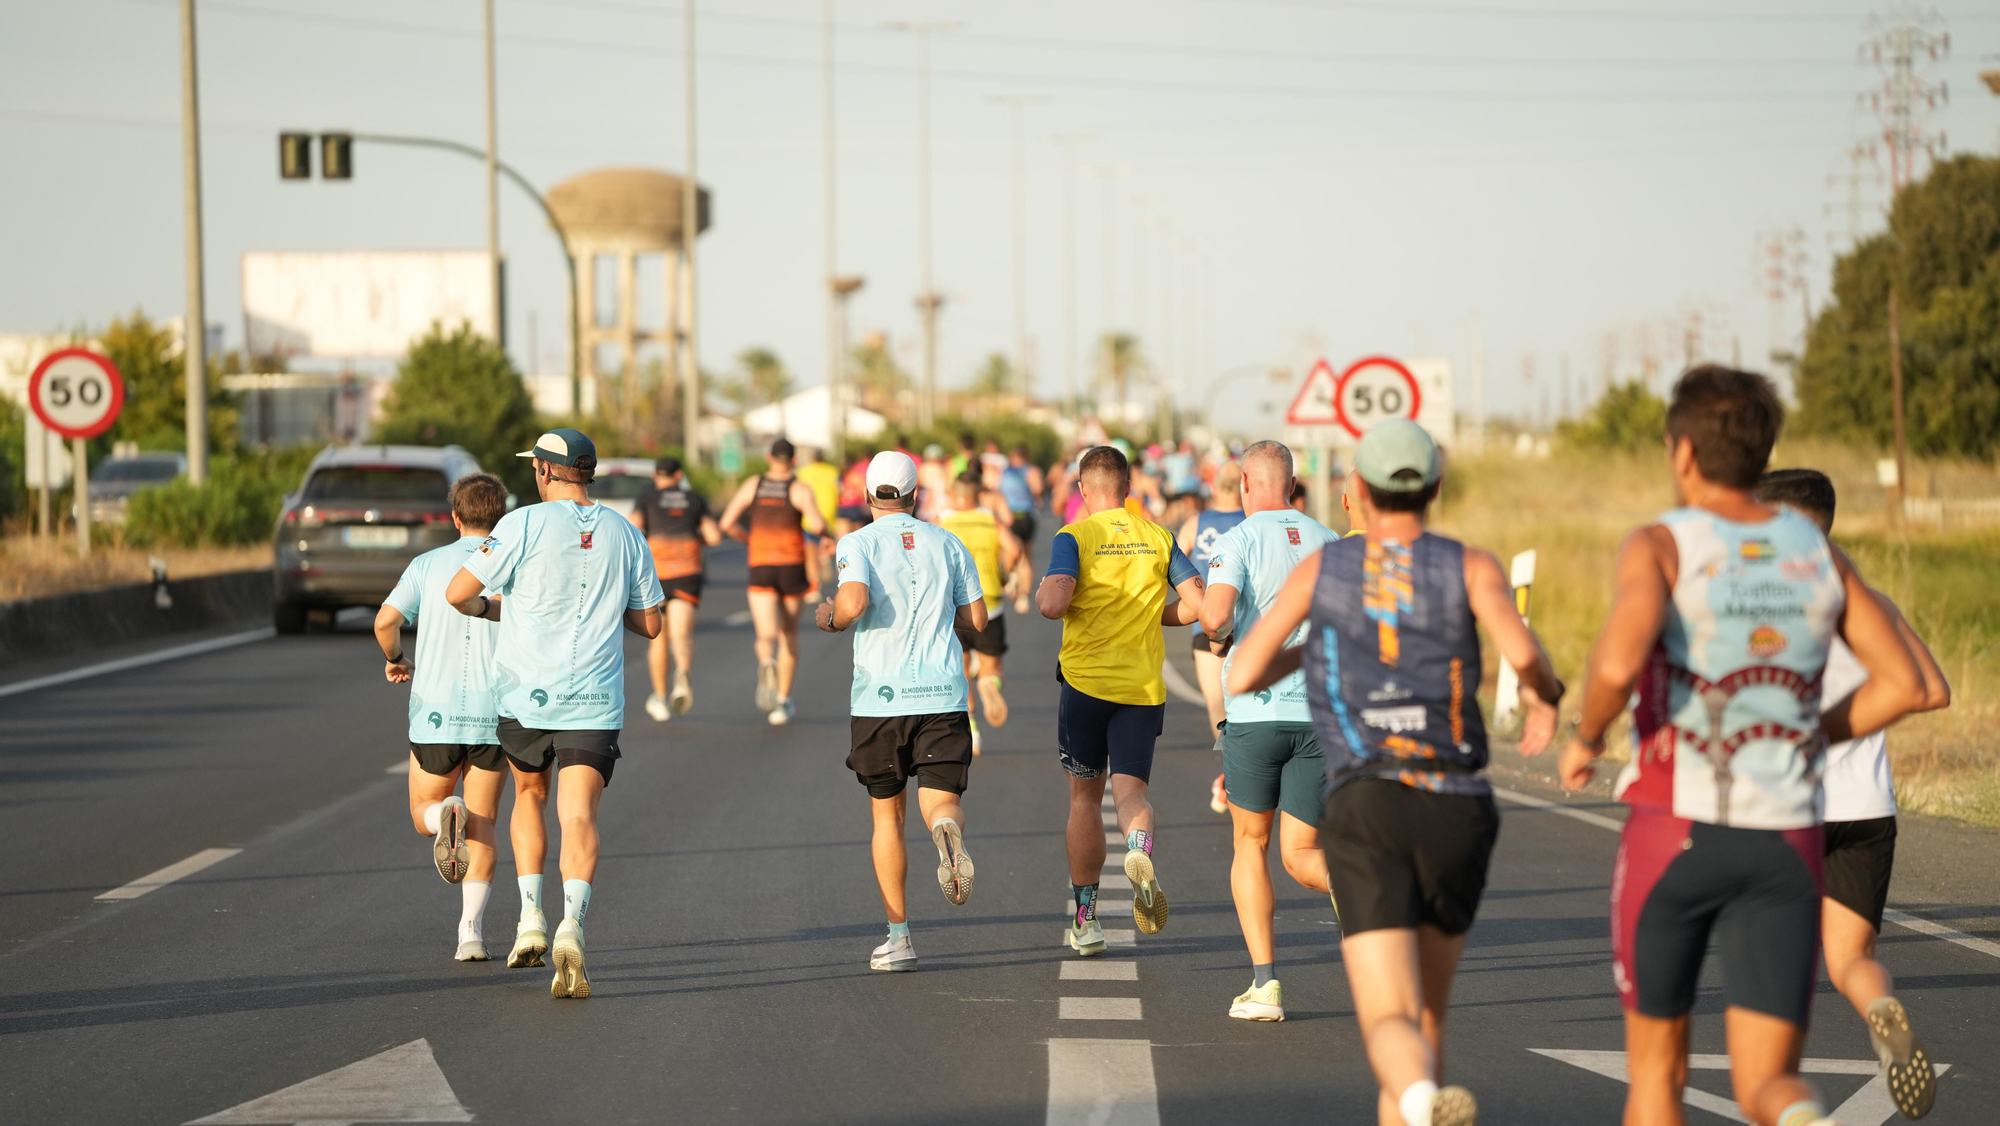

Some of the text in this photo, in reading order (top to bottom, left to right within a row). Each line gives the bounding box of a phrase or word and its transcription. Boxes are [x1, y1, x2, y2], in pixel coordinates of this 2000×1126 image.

[50, 377, 102, 407] 50
[1354, 386, 1403, 414] 50
[901, 685, 933, 694] ALMODÓVAR
[556, 693, 590, 701] ALMODÓVAR
[601, 692, 610, 700] RÍO
[448, 715, 481, 723] ALMODÓVAR
